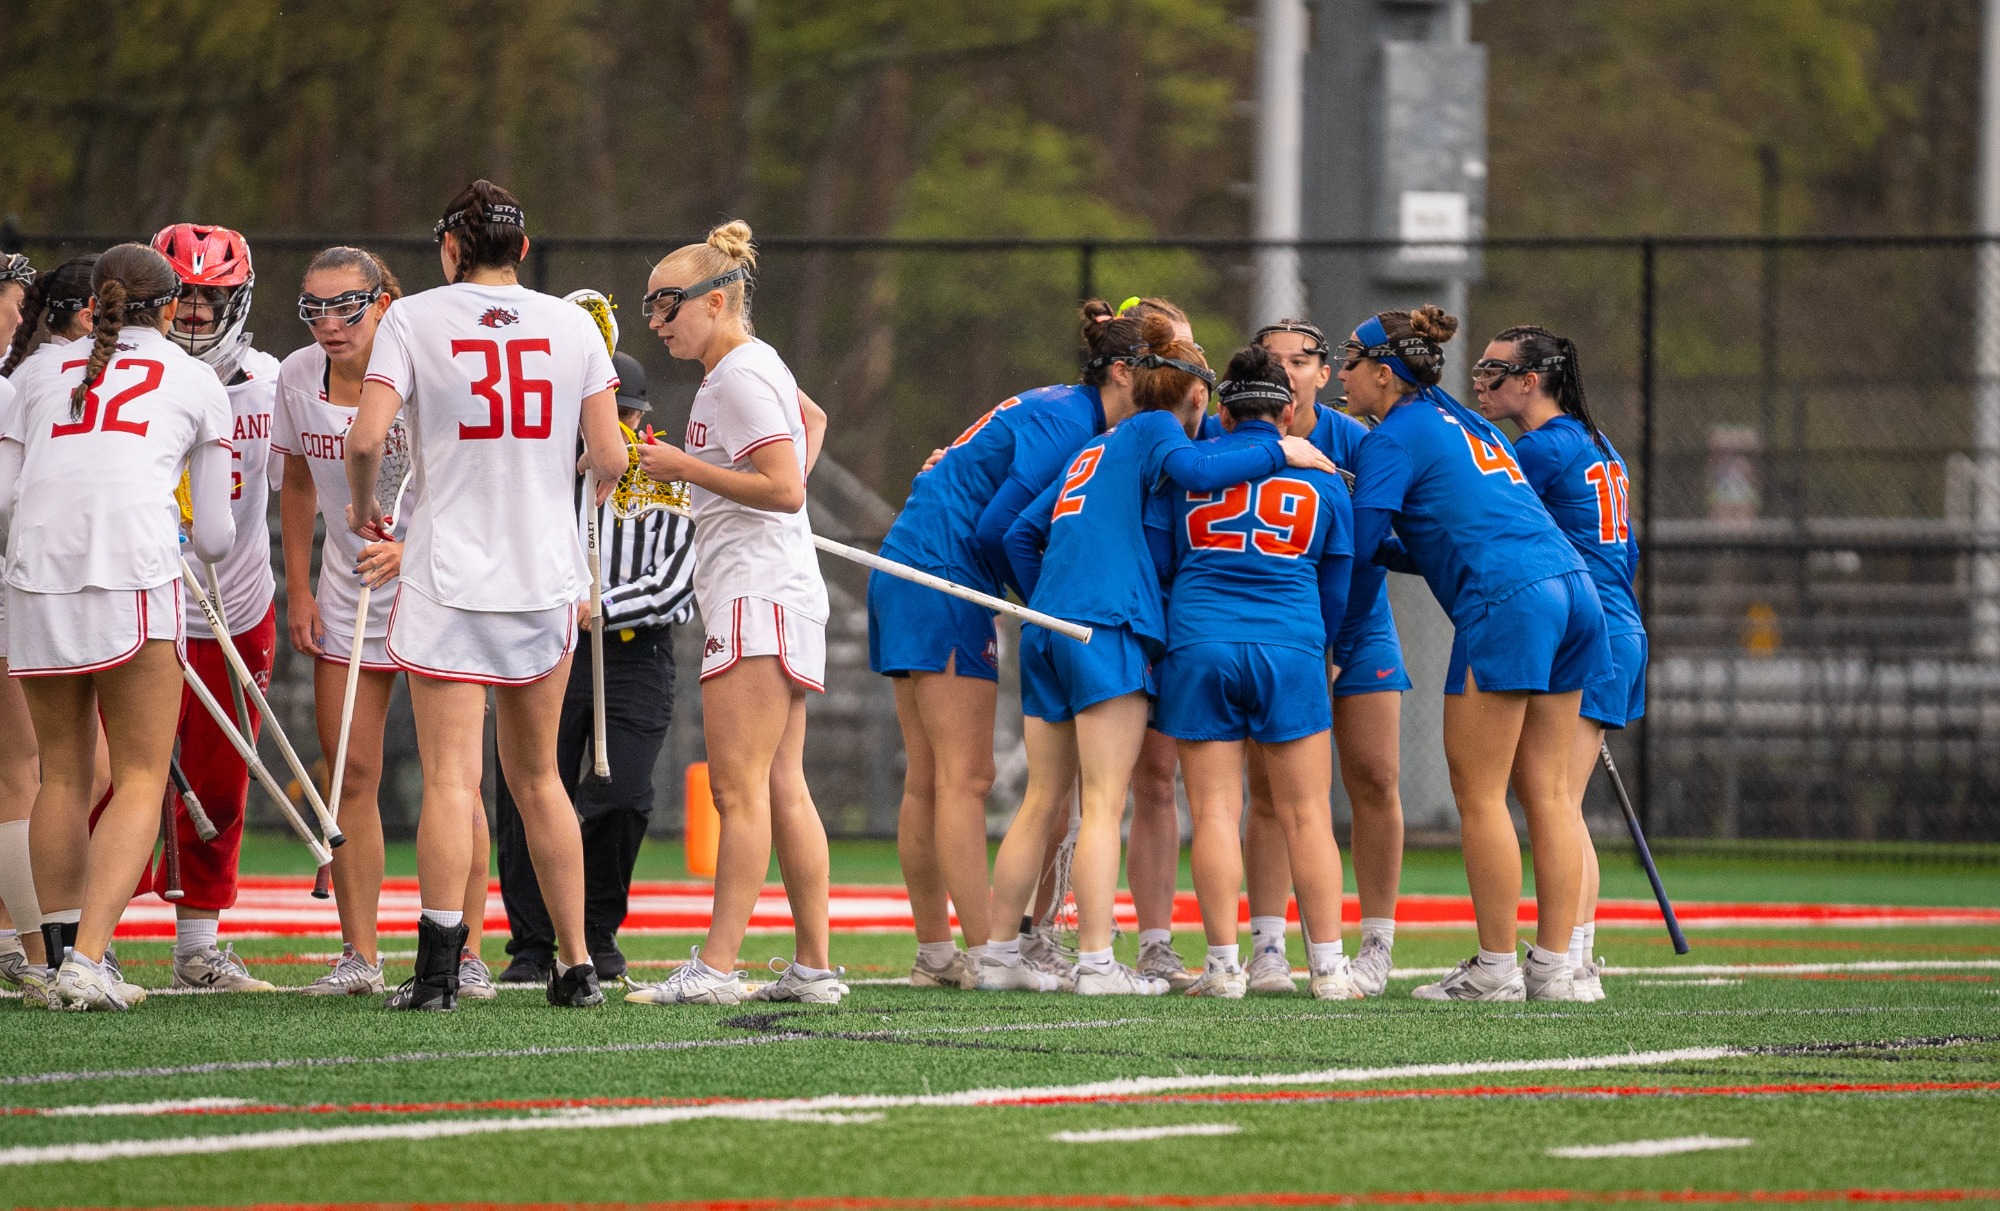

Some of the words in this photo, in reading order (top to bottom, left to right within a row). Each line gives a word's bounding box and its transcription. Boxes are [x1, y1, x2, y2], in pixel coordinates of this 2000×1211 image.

[492, 214, 516, 224] STX
[494, 204, 517, 214] STX
[713, 274, 734, 288] STX
[1369, 348, 1397, 357] STX
[1399, 337, 1424, 347] STX
[1405, 347, 1430, 355] STX
[51, 358, 165, 439] 32
[450, 338, 553, 440] 36
[1459, 424, 1527, 485] 4
[1051, 443, 1106, 524] 2
[1584, 460, 1630, 544] 10
[1185, 476, 1320, 560] 29
[199, 599, 219, 627] GAIT
